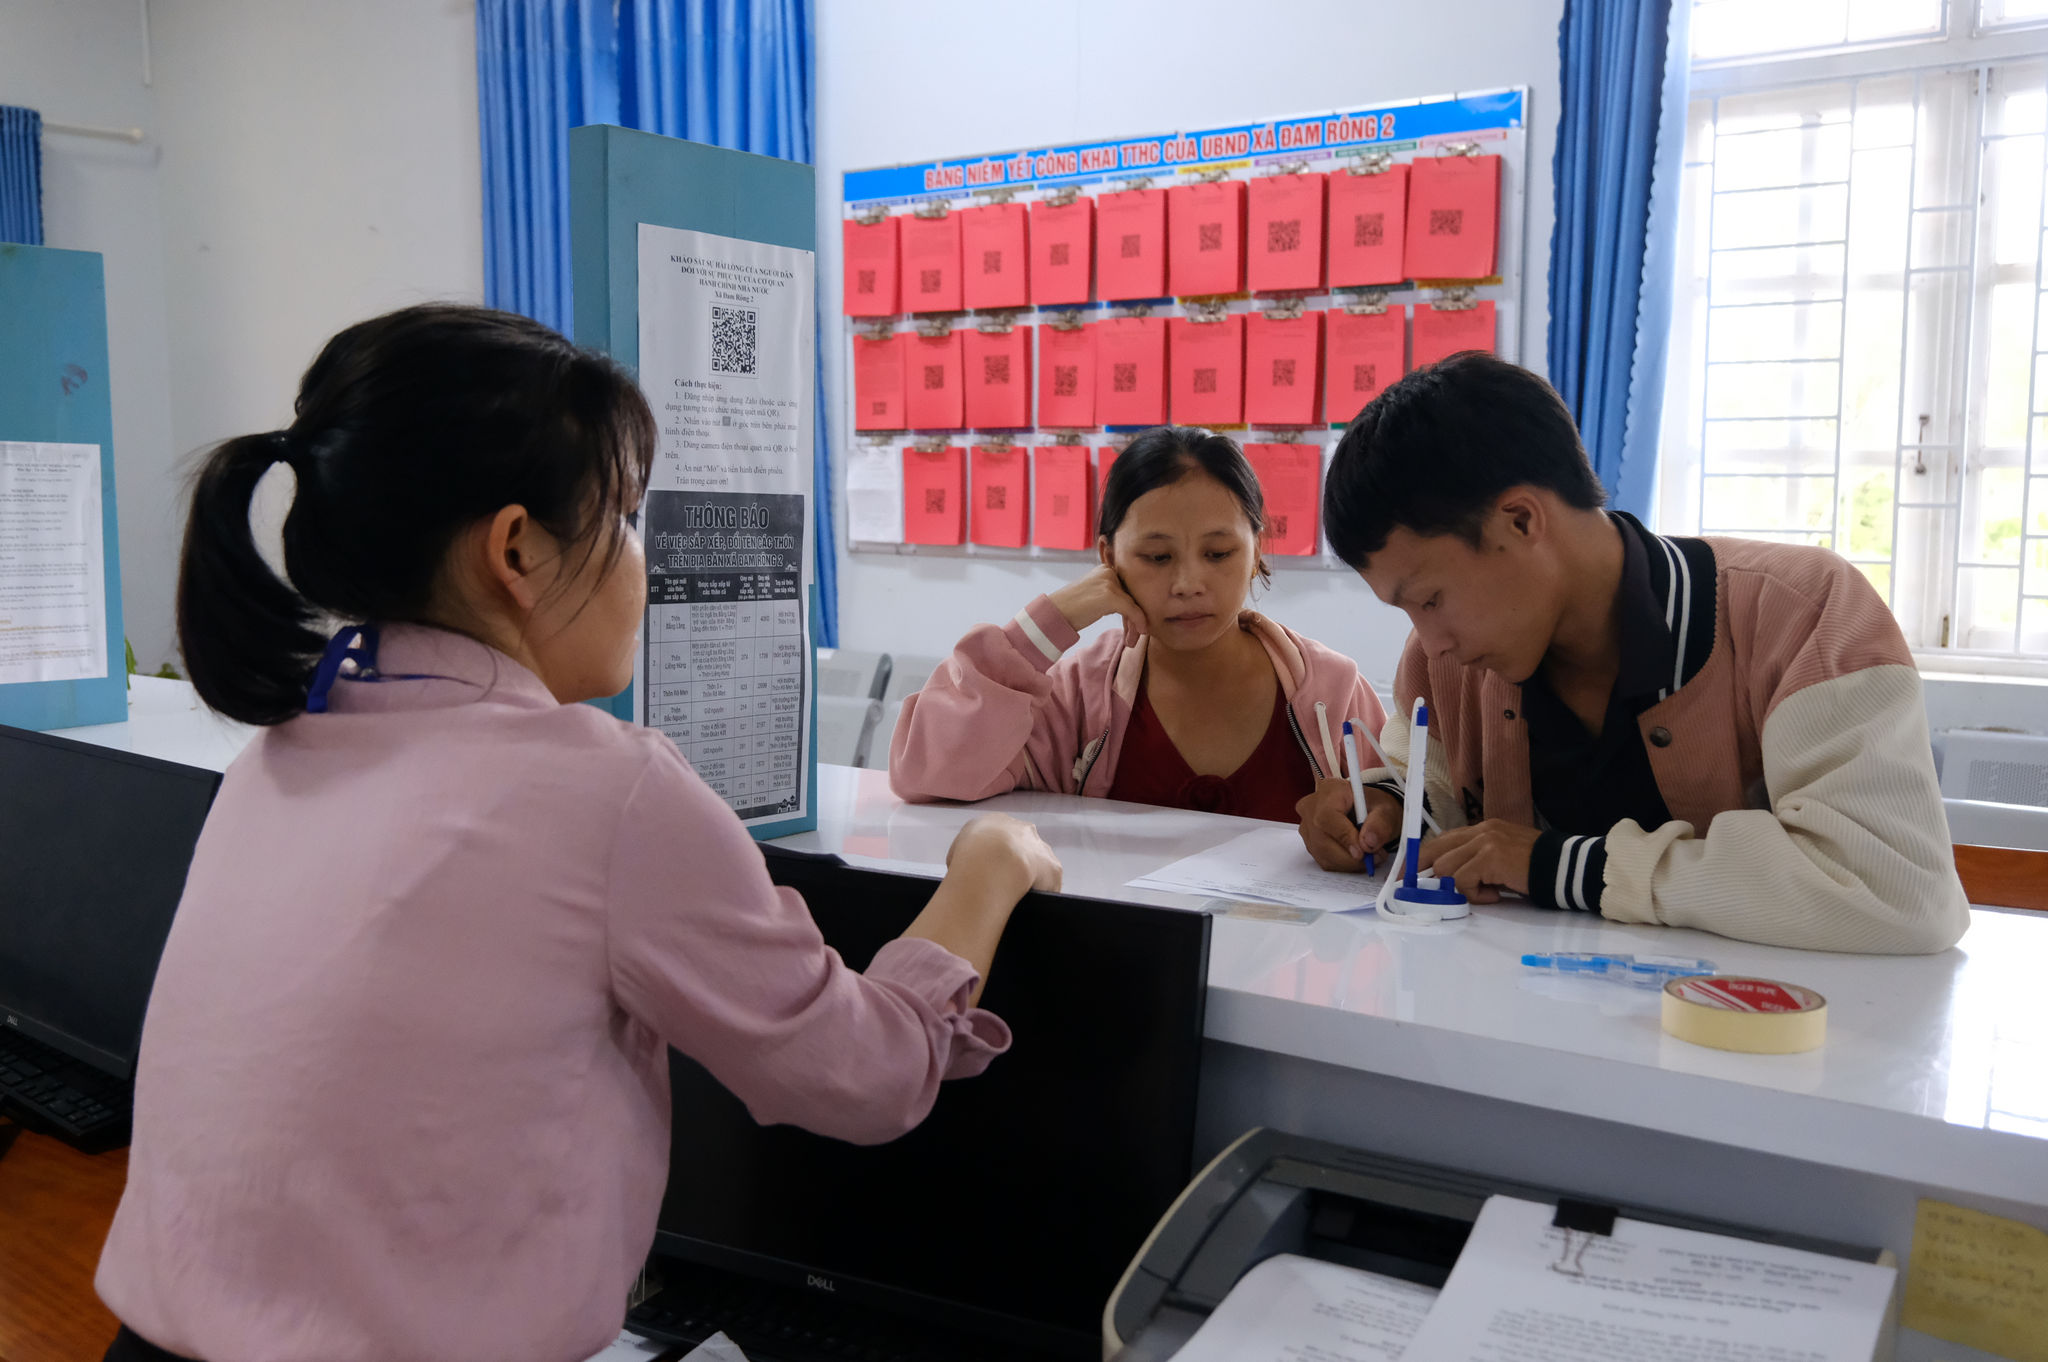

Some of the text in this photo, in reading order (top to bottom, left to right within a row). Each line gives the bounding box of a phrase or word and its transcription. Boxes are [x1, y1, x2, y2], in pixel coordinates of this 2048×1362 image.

[925, 161, 962, 191] BẢNG
[967, 158, 1004, 185] NIÊM
[1007, 151, 1033, 180] YẾT
[1037, 150, 1077, 178] CÔNG
[1081, 146, 1117, 172] KHAI
[1121, 142, 1159, 167] TTHC
[1164, 133, 1197, 164] CỦA
[1201, 133, 1248, 159] UBND
[1253, 123, 1276, 153] XÃ
[1280, 124, 1320, 149] ĐAM
[1327, 114, 1376, 144] RÔNG
[1382, 115, 1395, 138] 2
[780, 270, 794, 279] DÂN
[675, 379, 693, 388] Cách
[773, 445, 783, 453] QR
[685, 501, 769, 530] THÔNG BÁO
[655, 531, 668, 550] VỀ
[669, 534, 687, 552] VIỆC
[689, 532, 706, 550] SẮP
[742, 533, 756, 549] TÊN
[757, 534, 773, 549] CÁC
[774, 534, 795, 549] THÔN
[668, 552, 783, 570] TRÊN ĐỊA BÀN XÃ ĐAM RÔNG 2
[1728, 983, 1776, 995] TIGER TAPE
[808, 1274, 836, 1292] DELL
